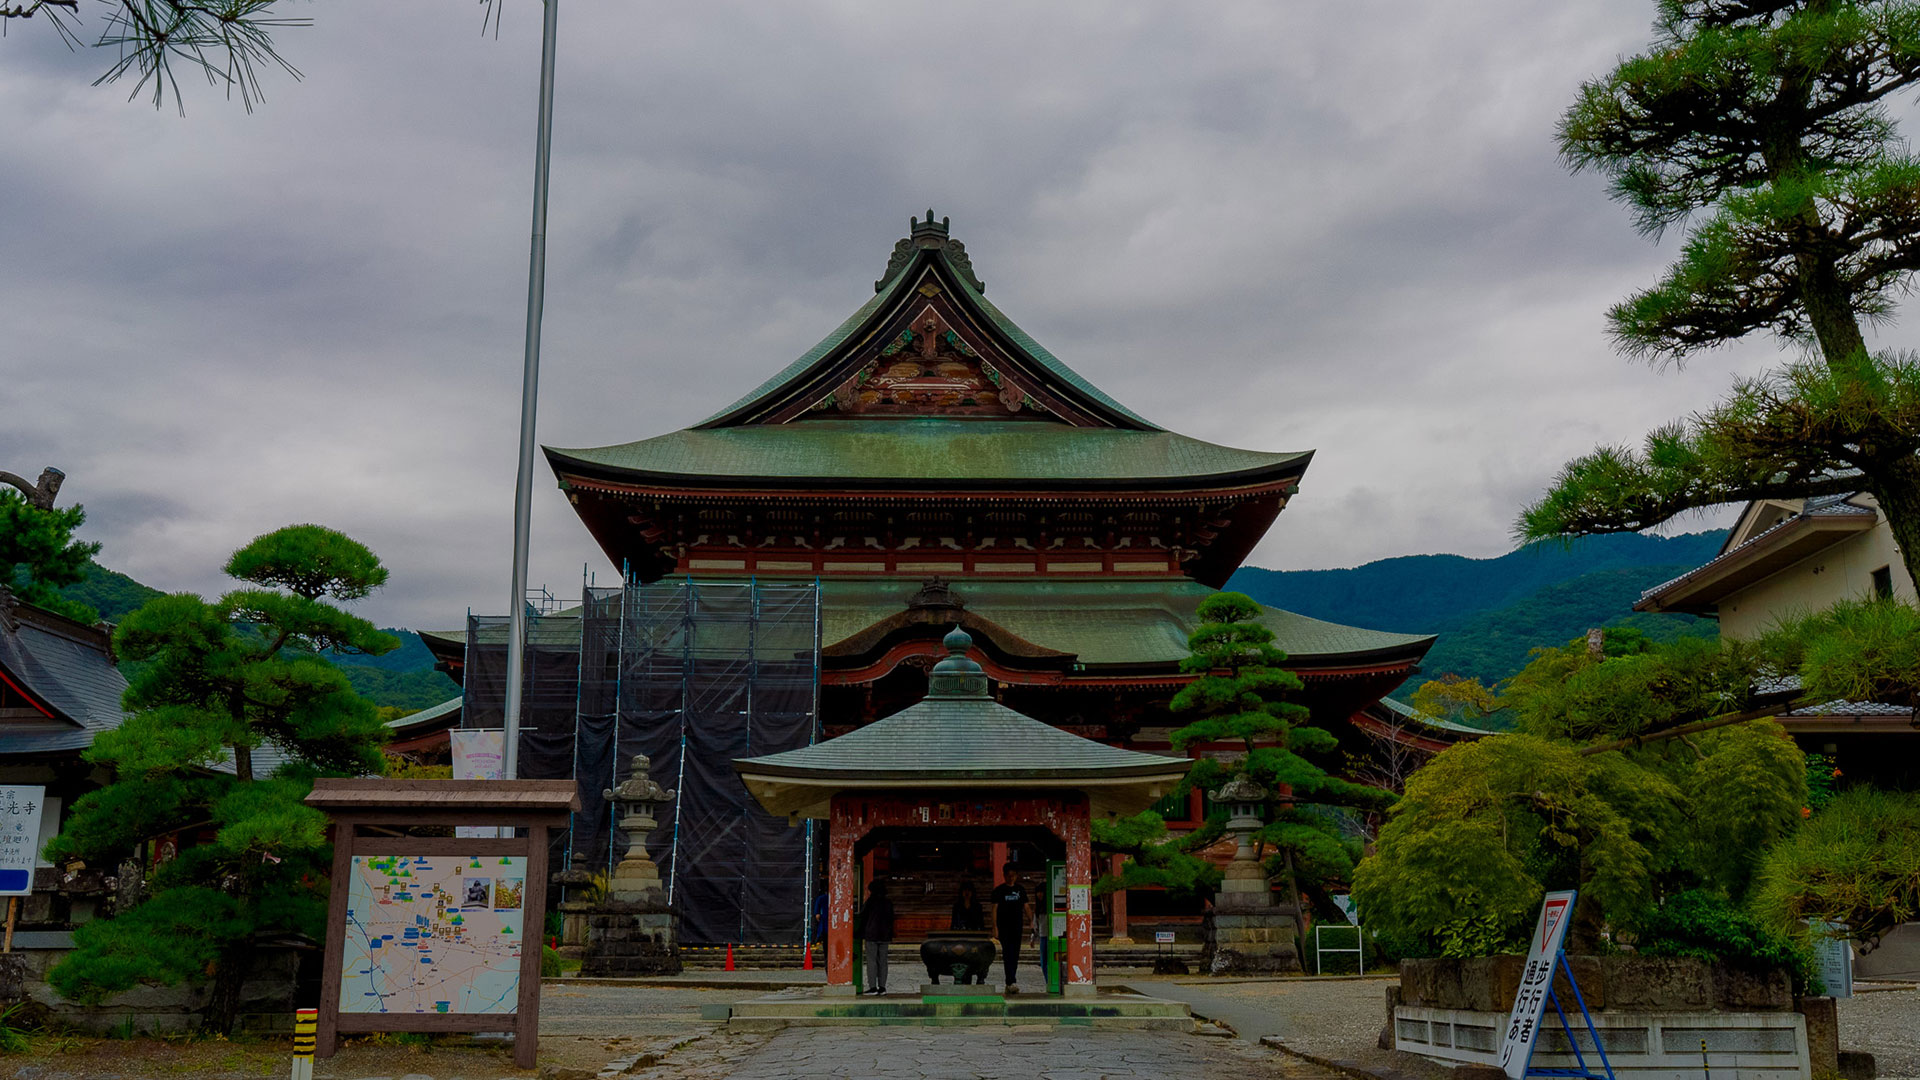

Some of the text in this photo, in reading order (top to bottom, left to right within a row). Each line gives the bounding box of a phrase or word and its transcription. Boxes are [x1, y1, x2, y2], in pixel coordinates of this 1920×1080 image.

[1503, 960, 1538, 1069] 通行あり
[1520, 960, 1550, 1044] 歩行者
